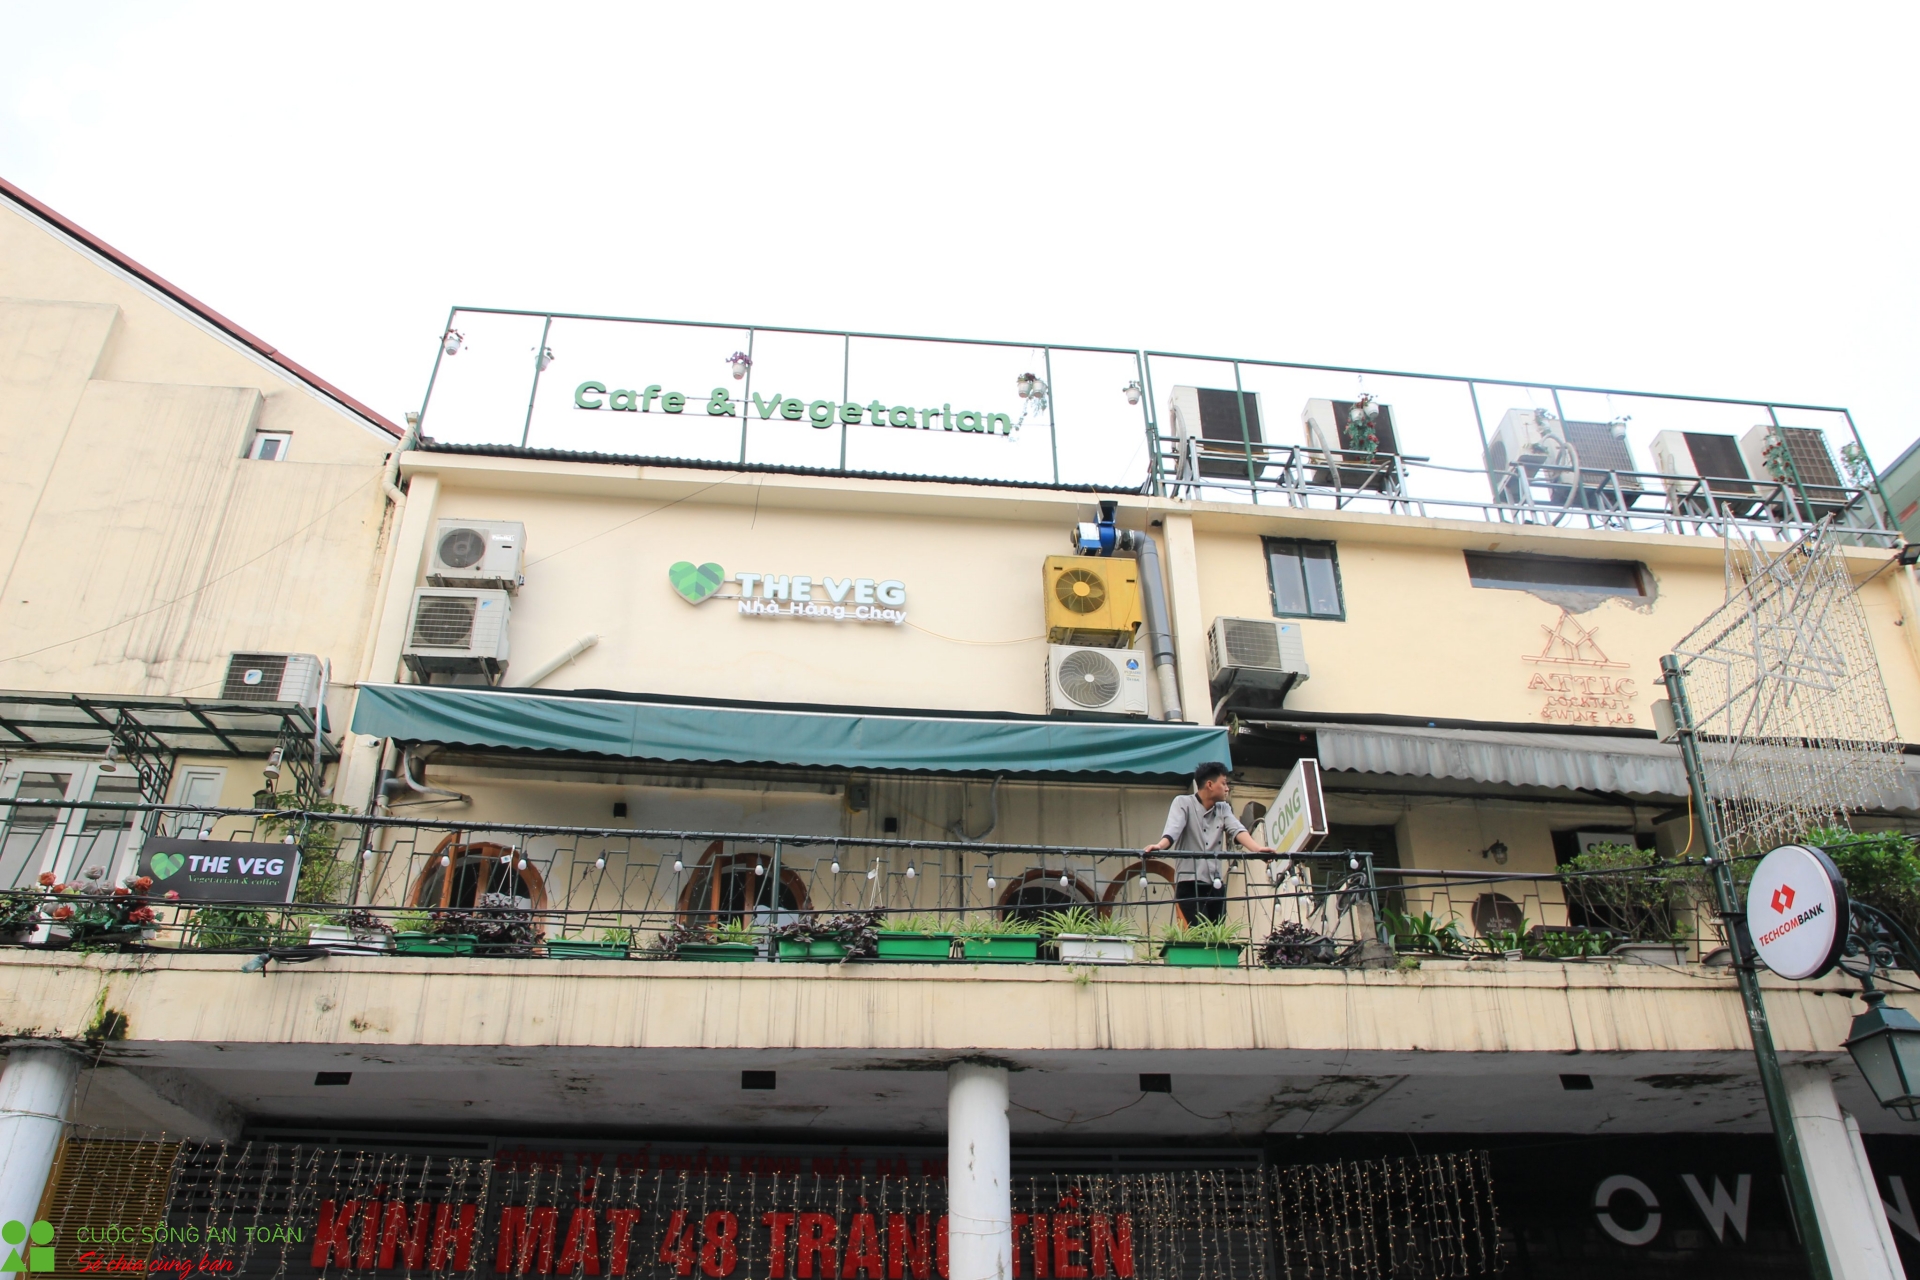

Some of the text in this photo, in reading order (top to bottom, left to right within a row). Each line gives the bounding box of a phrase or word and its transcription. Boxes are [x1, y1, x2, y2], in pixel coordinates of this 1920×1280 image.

[574, 380, 1011, 435] Cafe & Vegetarian
[735, 571, 907, 608] THE VEG
[738, 600, 907, 625] Nhà Hàng Chay
[1528, 673, 1638, 698] ATTIC
[1546, 696, 1629, 709] COCKTAIL
[1605, 712, 1635, 725] LAB
[189, 855, 285, 875] THE VEG
[189, 875, 280, 886] Vegetarian & coffee
[1759, 903, 1824, 947] TECHCOMBANK
[495, 1143, 564, 1177] CÔNG
[574, 1152, 605, 1177] TY
[310, 1183, 478, 1270] KÍNH
[495, 1178, 641, 1276] MẮT
[659, 1208, 738, 1278] 48
